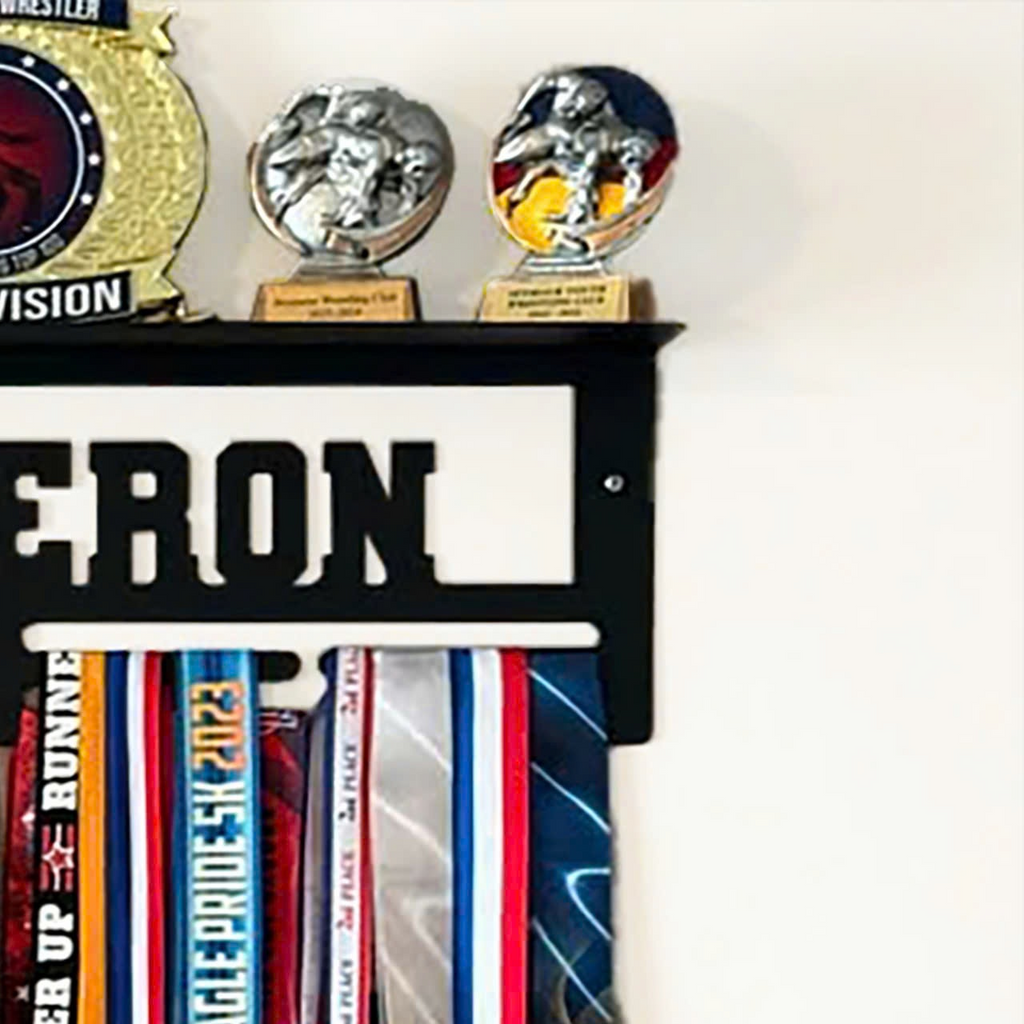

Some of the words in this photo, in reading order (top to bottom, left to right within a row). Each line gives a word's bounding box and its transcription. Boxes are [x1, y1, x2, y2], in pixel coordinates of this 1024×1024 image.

[189, 680, 245, 771] 2023
[36, 903, 74, 962] UP
[193, 834, 246, 942] PRIDE
